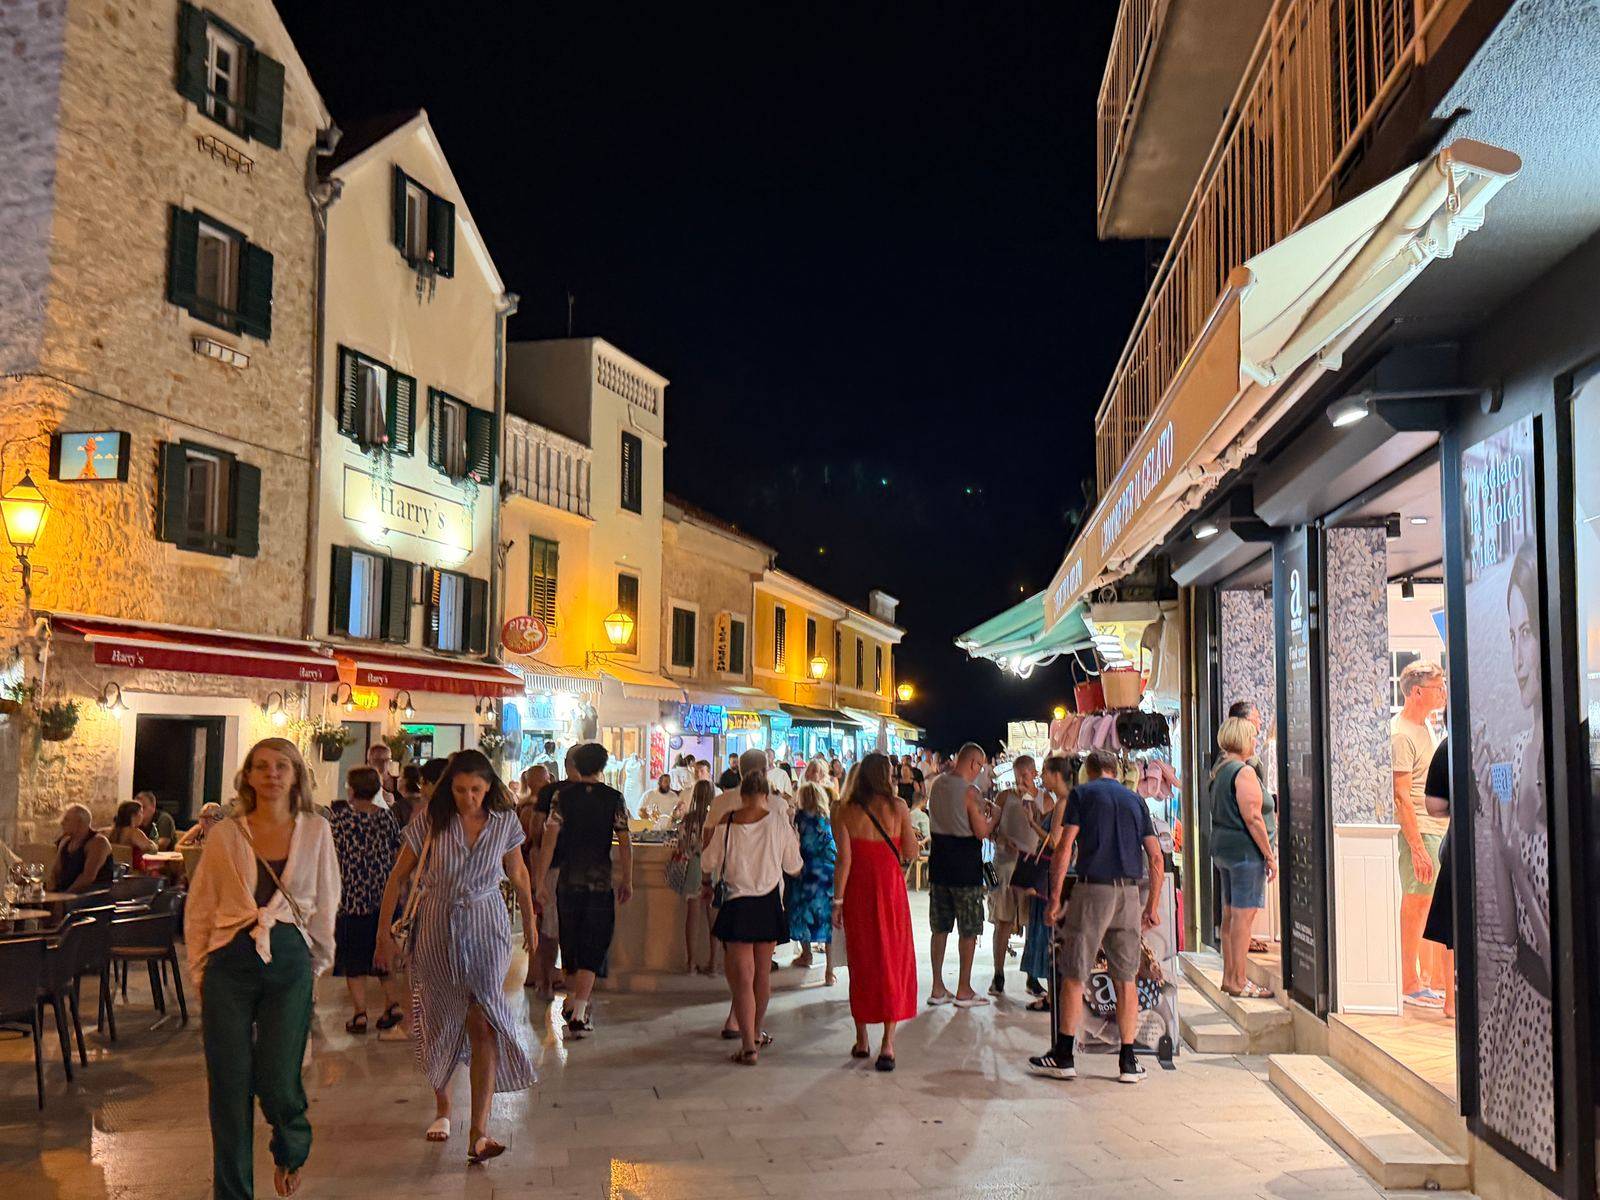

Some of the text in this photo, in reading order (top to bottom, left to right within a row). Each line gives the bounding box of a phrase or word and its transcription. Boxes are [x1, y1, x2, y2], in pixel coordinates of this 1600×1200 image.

[1142, 420, 1173, 501] GELATO
[1481, 453, 1521, 500] gelato
[380, 486, 446, 534] Harry's
[1470, 487, 1522, 536] la dolce
[510, 619, 538, 631] PIZZA
[112, 649, 144, 668] Harry's
[299, 665, 323, 681] Harry's
[1098, 1004, 1117, 1012] ROM
